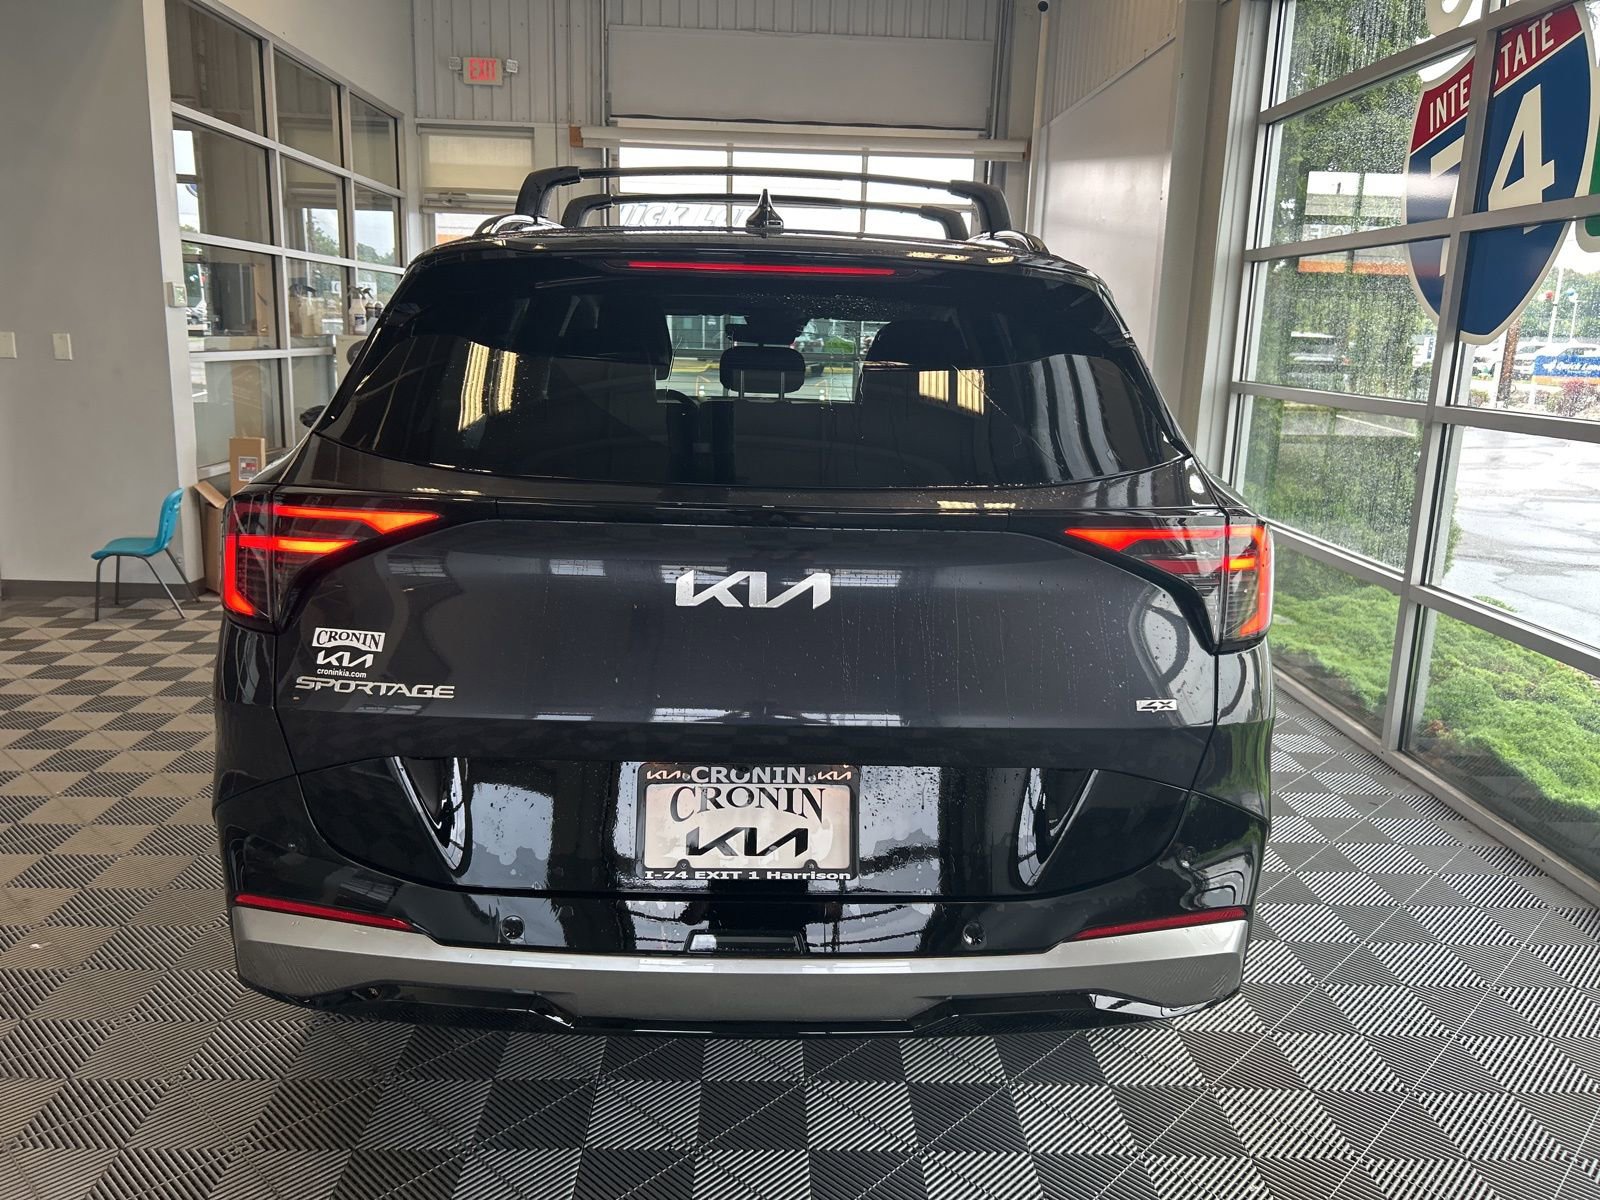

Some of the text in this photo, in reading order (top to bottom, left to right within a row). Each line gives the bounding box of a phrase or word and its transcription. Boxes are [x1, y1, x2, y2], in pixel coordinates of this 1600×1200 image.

[468, 58, 497, 80] EXIT
[675, 569, 832, 610] KIA
[316, 629, 382, 650] CRONIN
[316, 650, 374, 668] KIA
[316, 667, 367, 679] croninkia.com
[295, 675, 455, 699] SPORTAGE
[690, 766, 806, 784] CRONIN
[670, 785, 826, 824] CRONIN
[686, 826, 809, 858] KIA
[644, 870, 851, 880] I-74 EXIT 1 Harrison
